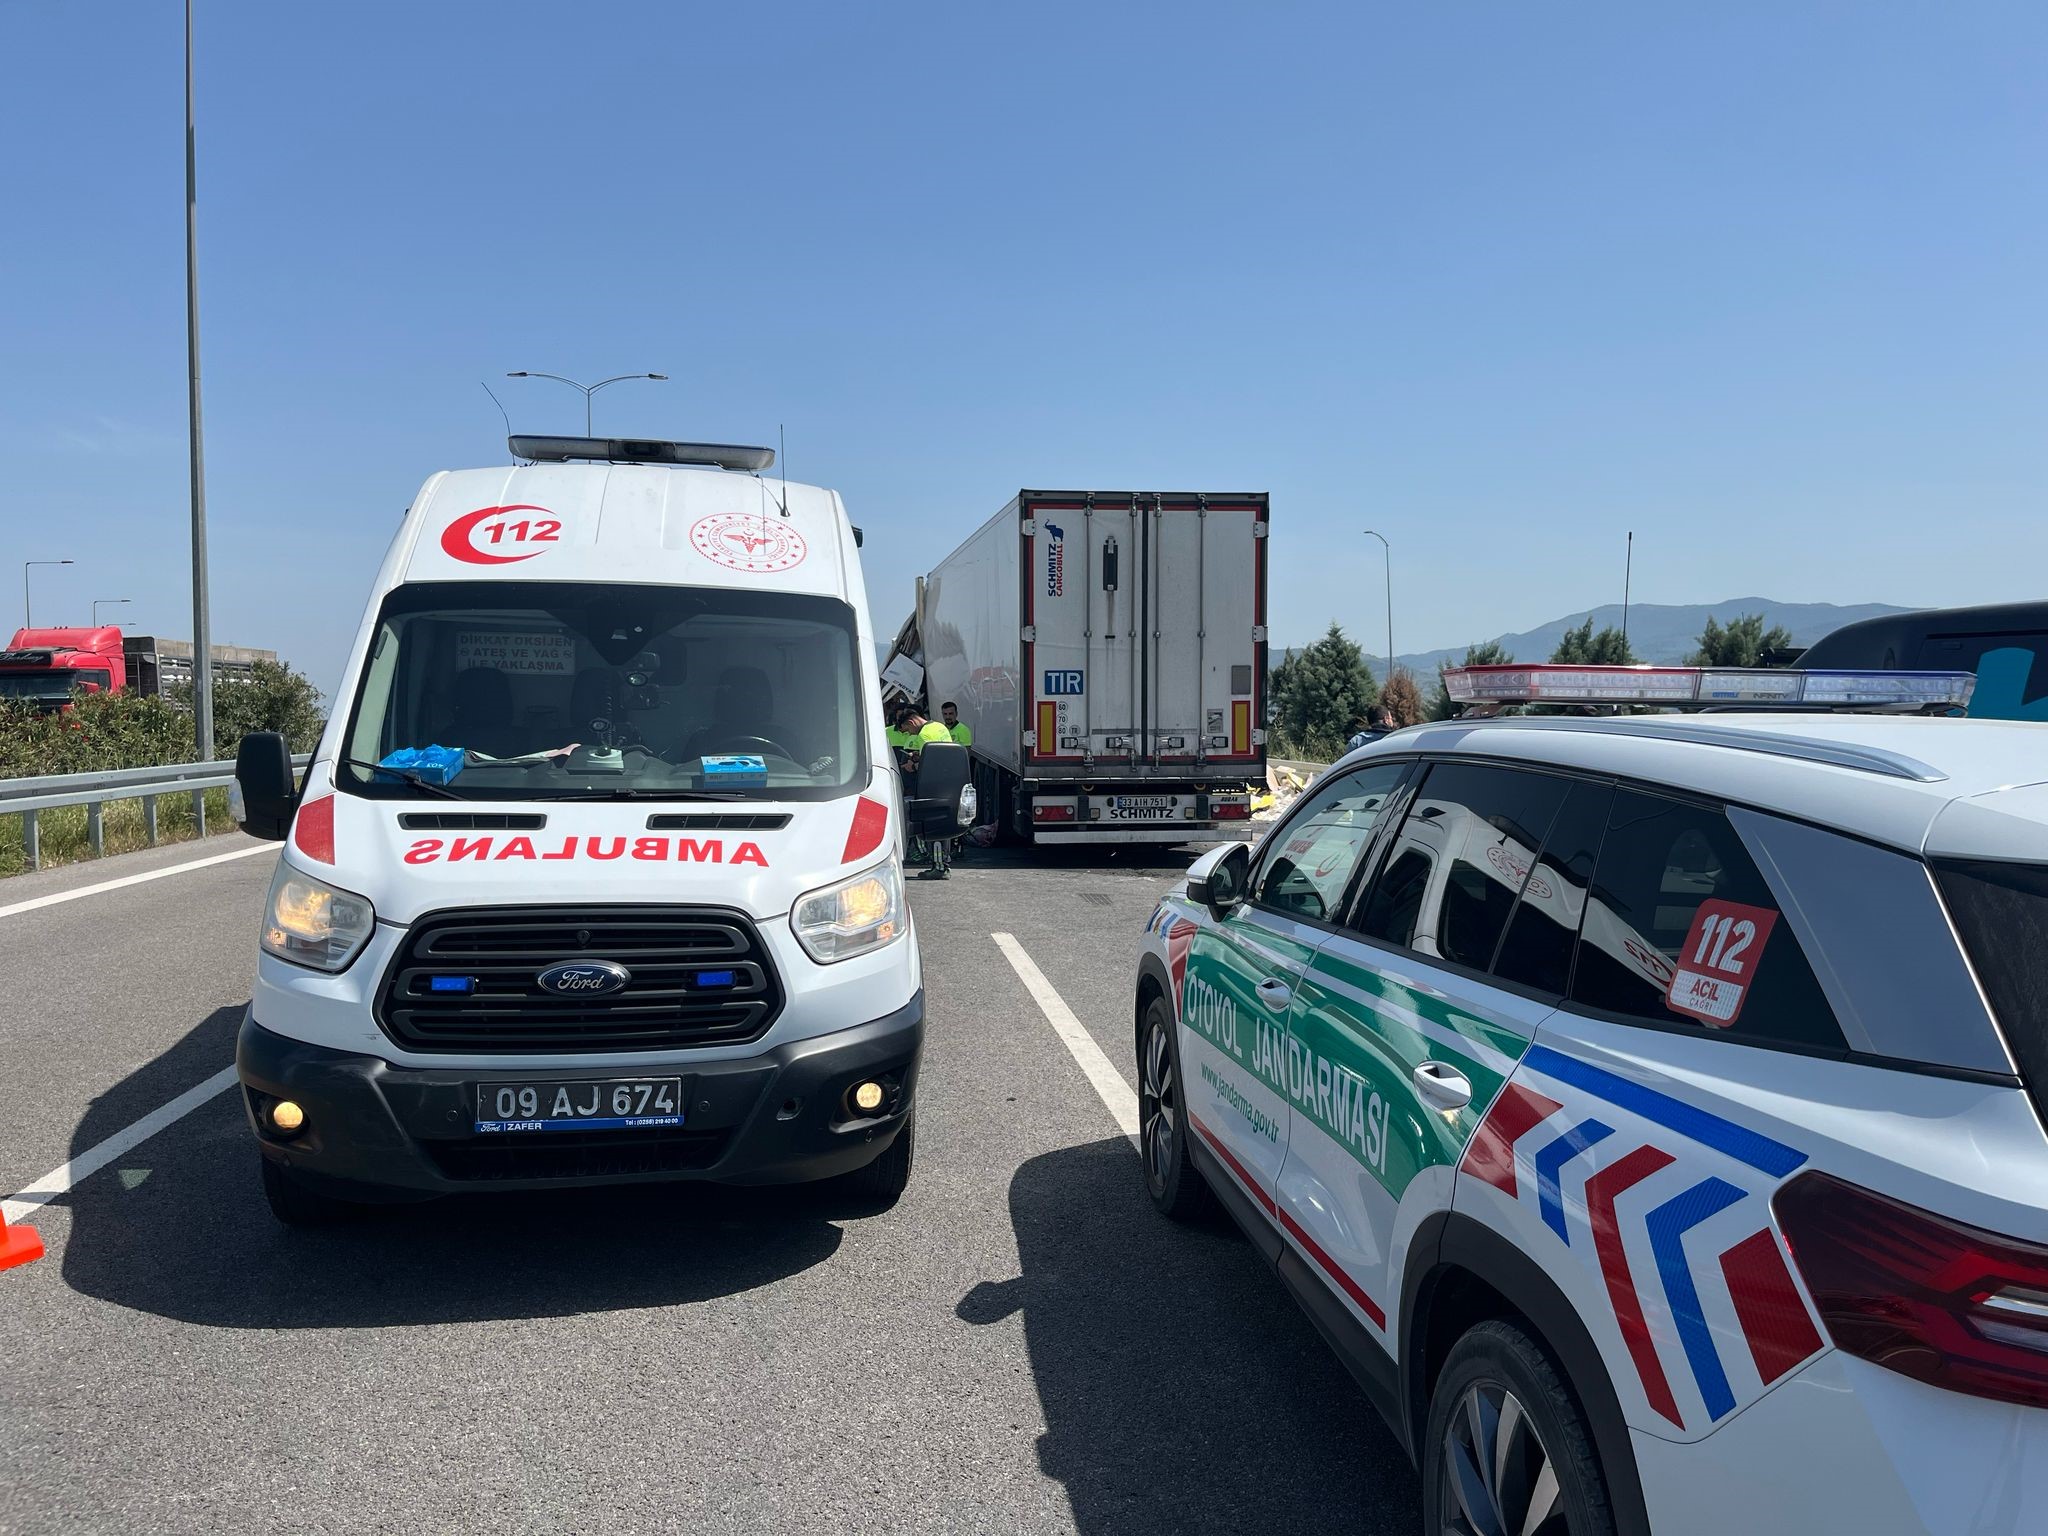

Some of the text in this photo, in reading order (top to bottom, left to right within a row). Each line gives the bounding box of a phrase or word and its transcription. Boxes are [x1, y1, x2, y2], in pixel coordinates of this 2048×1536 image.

[484, 520, 561, 543] 112
[1048, 544, 1056, 597] SCHMITZ
[511, 648, 529, 658] VE
[1047, 672, 1081, 693] TIR
[1110, 808, 1174, 819] SCHMITZ
[1122, 798, 1132, 807] 33
[1693, 913, 1756, 974] 112
[557, 970, 605, 990] Ford
[1187, 974, 1391, 1176] OTOYOL JANDARMASI
[496, 1084, 674, 1118] 09 AJ 674
[1201, 1061, 1280, 1144] www.jandarma.gov.tr
[480, 1123, 501, 1132] Ford
[507, 1122, 542, 1131] ZAFER
